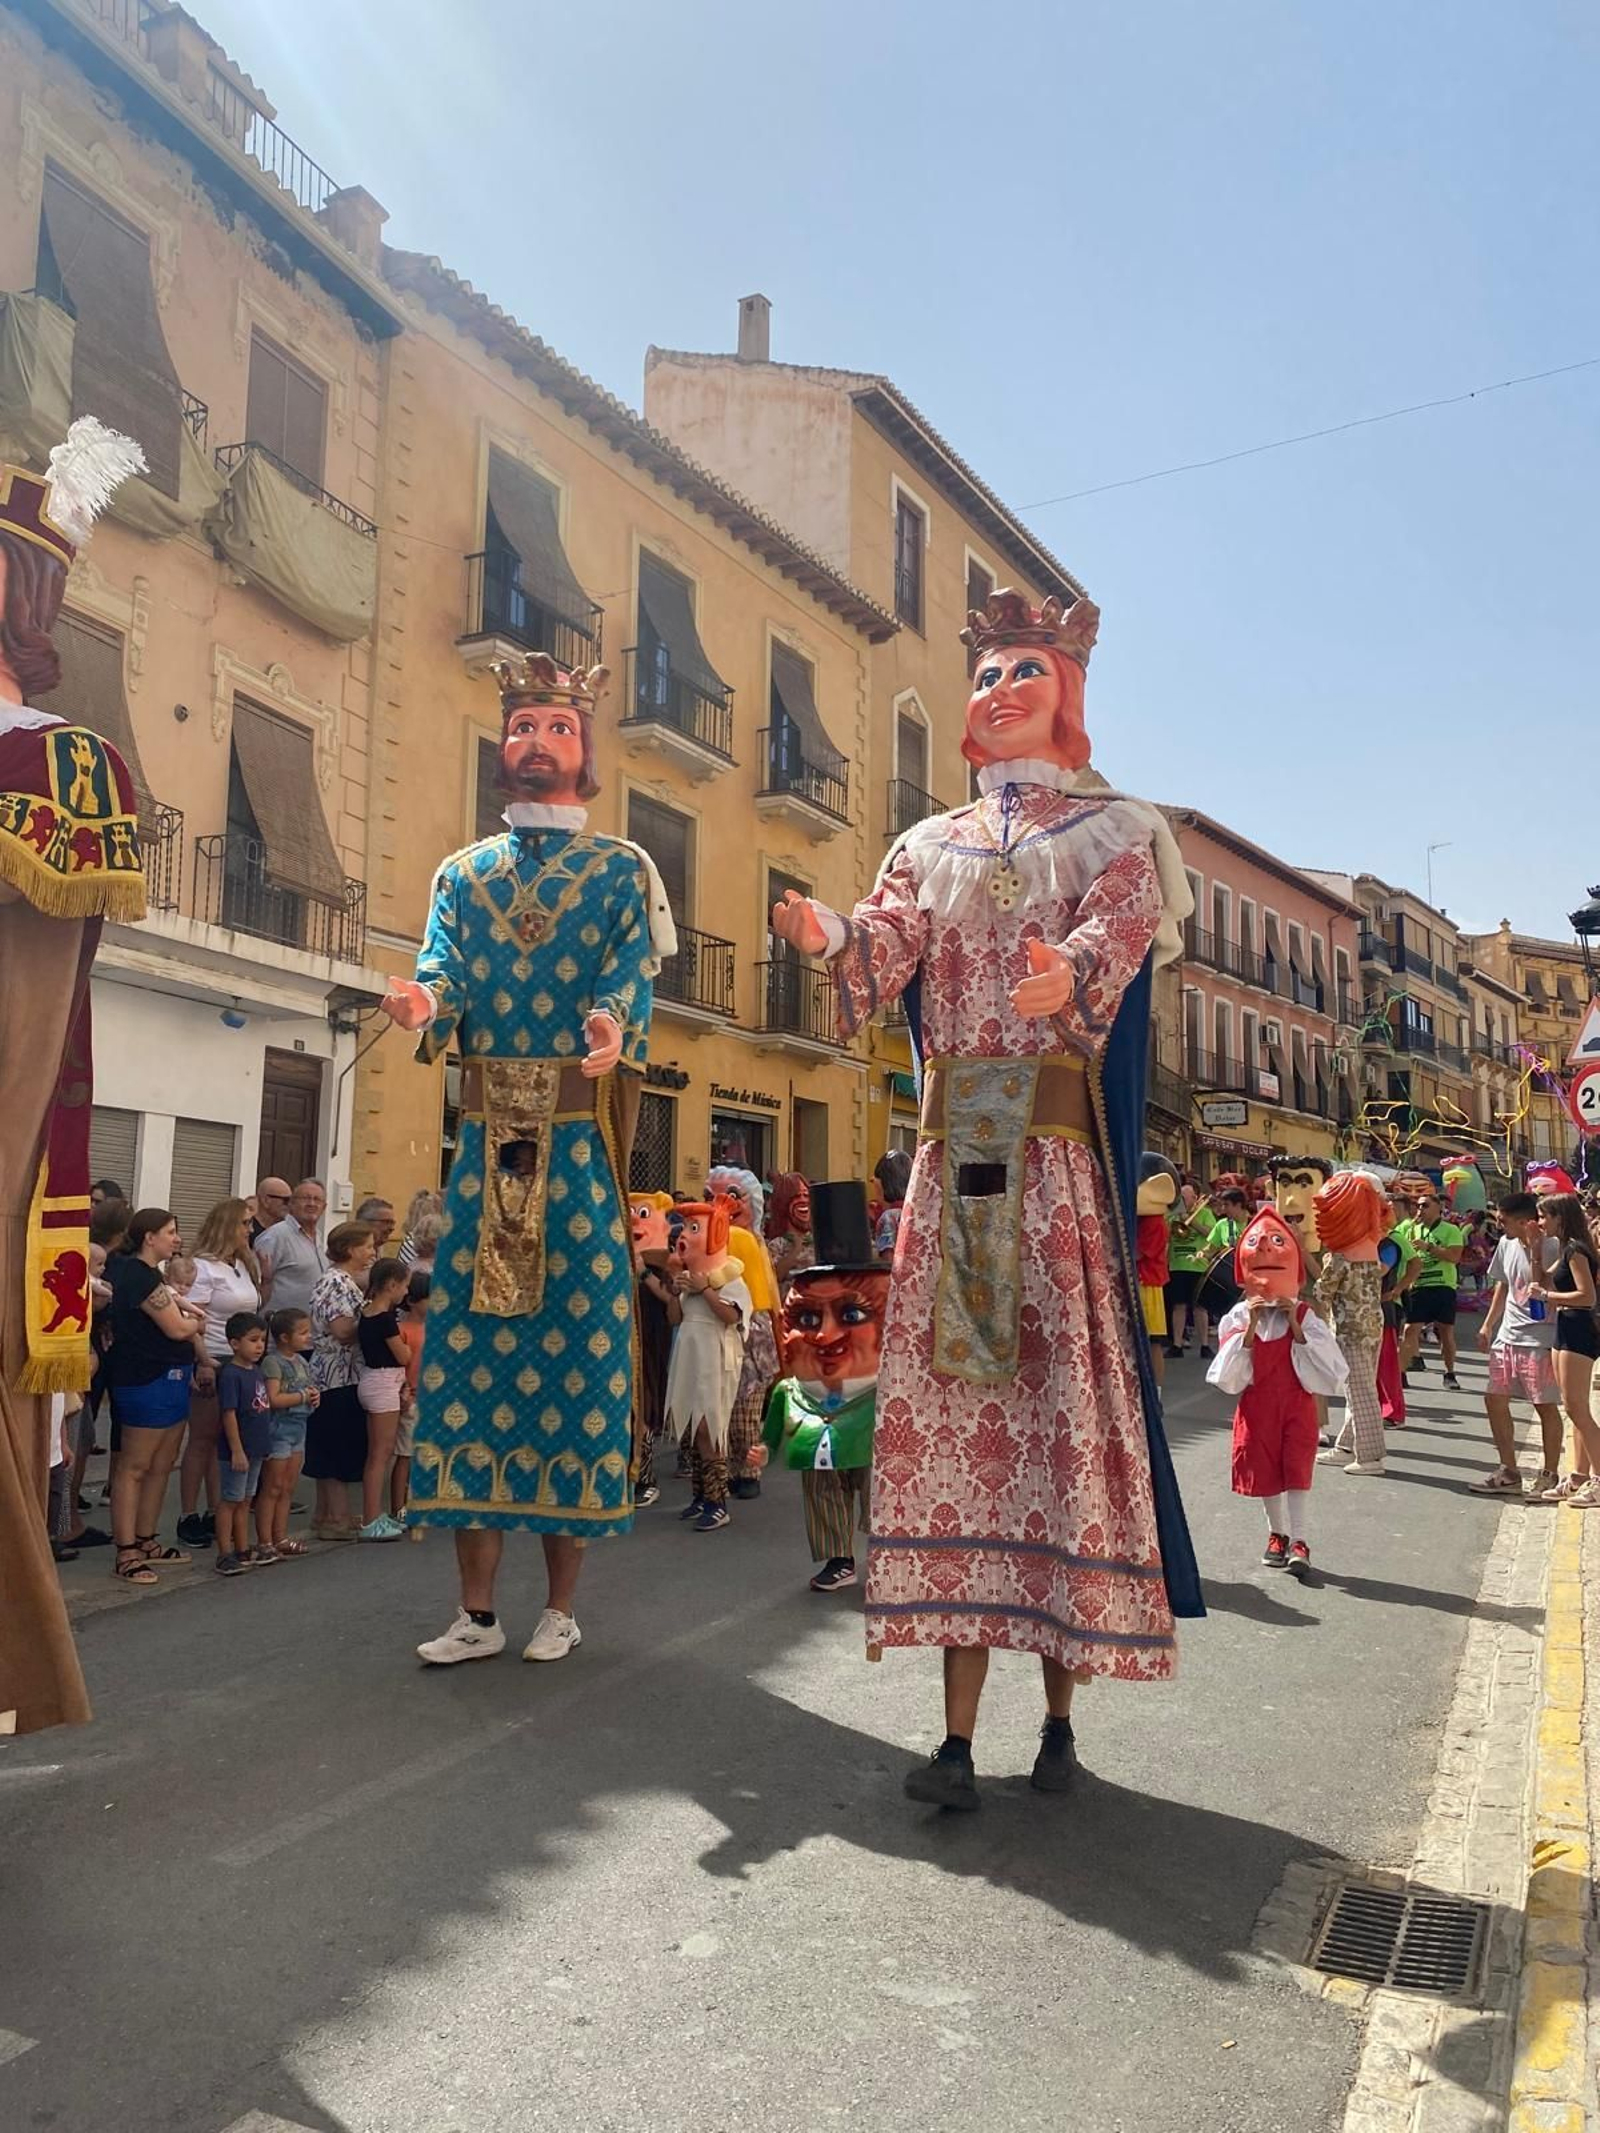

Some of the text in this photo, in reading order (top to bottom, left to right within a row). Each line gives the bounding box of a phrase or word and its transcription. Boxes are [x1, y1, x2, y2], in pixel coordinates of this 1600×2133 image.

[710, 1083, 739, 1101] Tienda
[740, 1089, 751, 1103] de
[1581, 1087, 1600, 1109] 2
